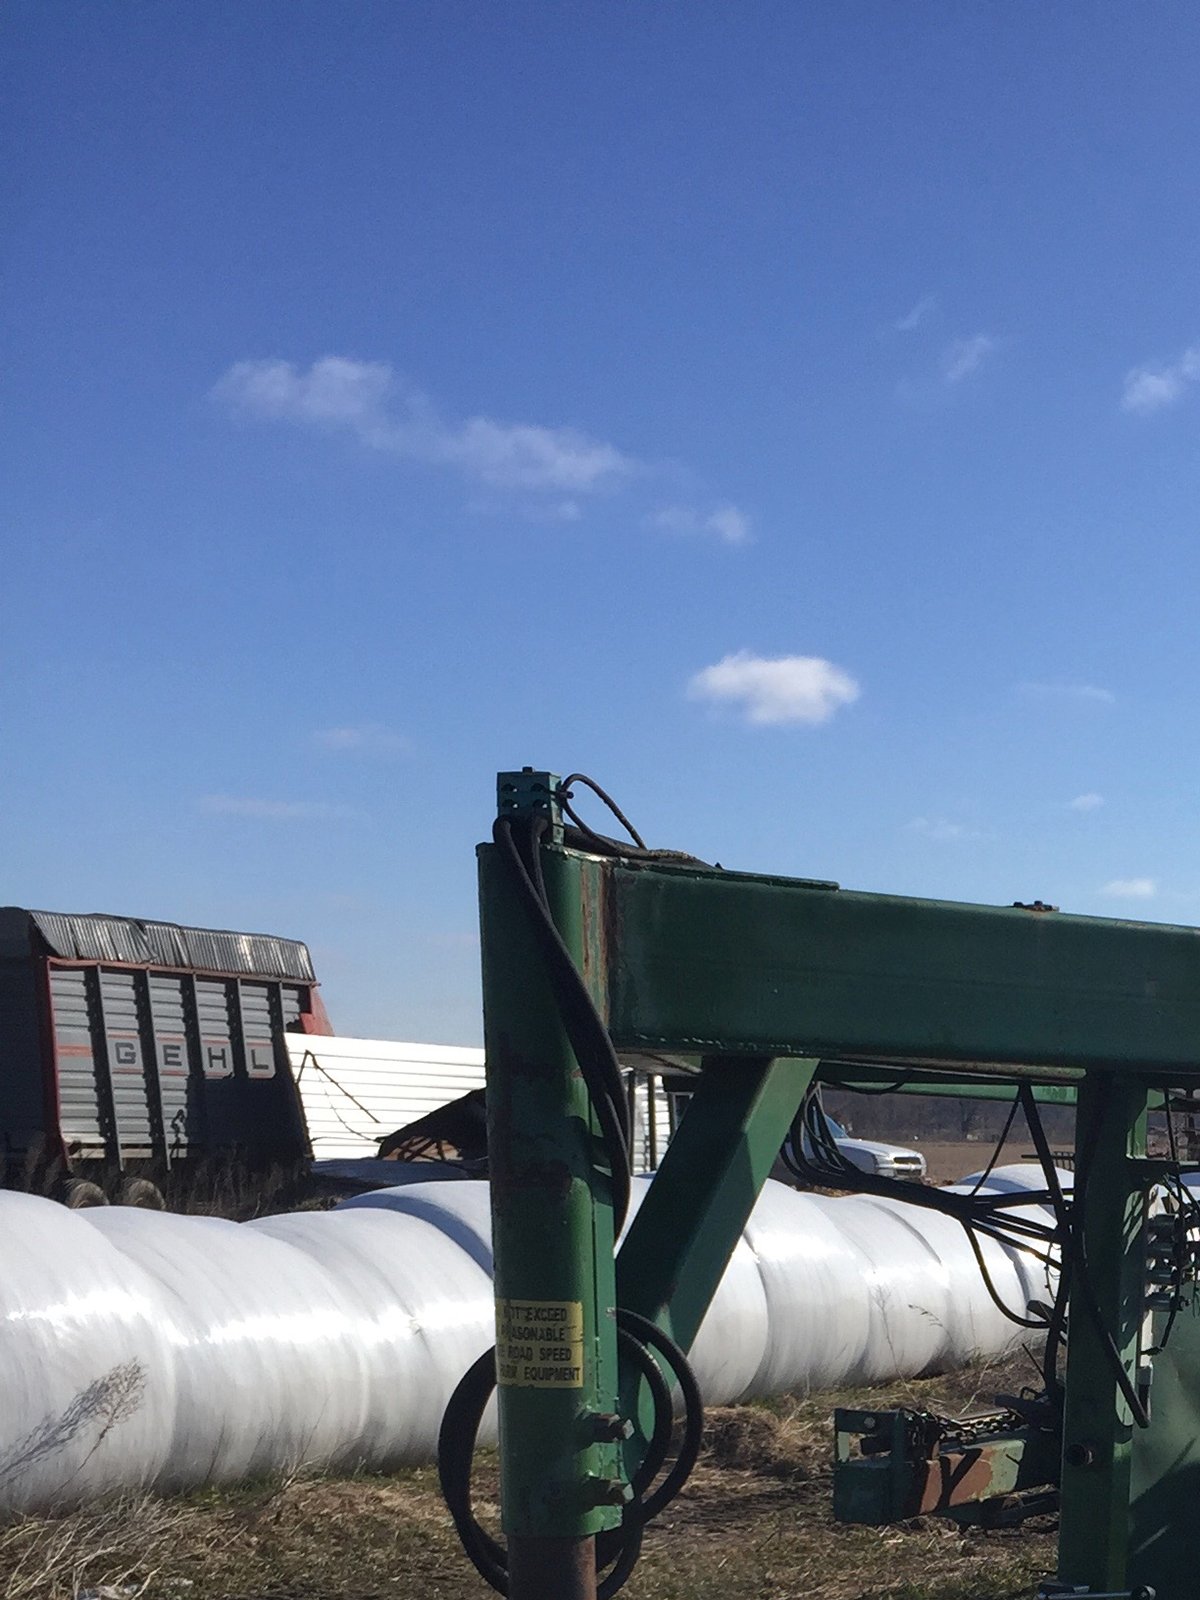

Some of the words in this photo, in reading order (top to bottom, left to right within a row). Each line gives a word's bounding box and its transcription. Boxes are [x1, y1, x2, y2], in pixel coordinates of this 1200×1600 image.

[115, 1042, 269, 1070] GEHL
[504, 1306, 522, 1320] OT
[526, 1308, 568, 1322] EXCEED
[502, 1325, 566, 1342] ASONABLE
[508, 1346, 533, 1361] ROAD
[540, 1347, 573, 1362] SPEED
[524, 1367, 581, 1382] EQUIPMENT
